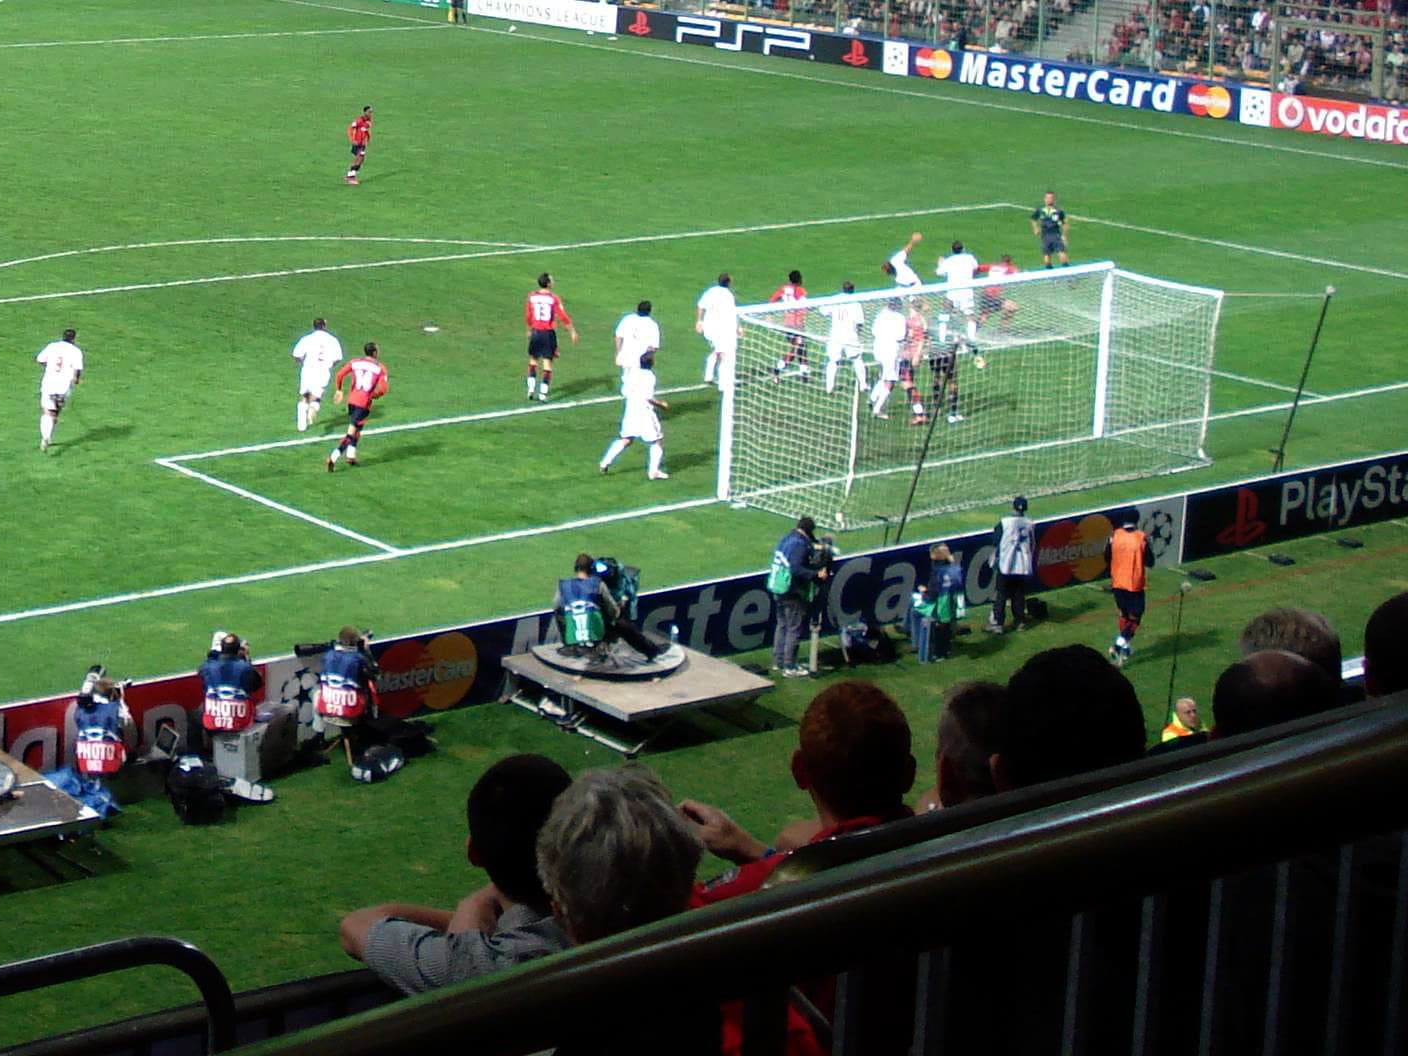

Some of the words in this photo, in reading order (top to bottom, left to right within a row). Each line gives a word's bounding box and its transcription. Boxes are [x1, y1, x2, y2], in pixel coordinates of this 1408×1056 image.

[556, 8, 609, 29] LEAGUE
[675, 15, 812, 56] PSP
[959, 51, 1177, 113] MasterCard
[205, 697, 247, 718] PHOTO
[77, 741, 115, 761] PHOTO
